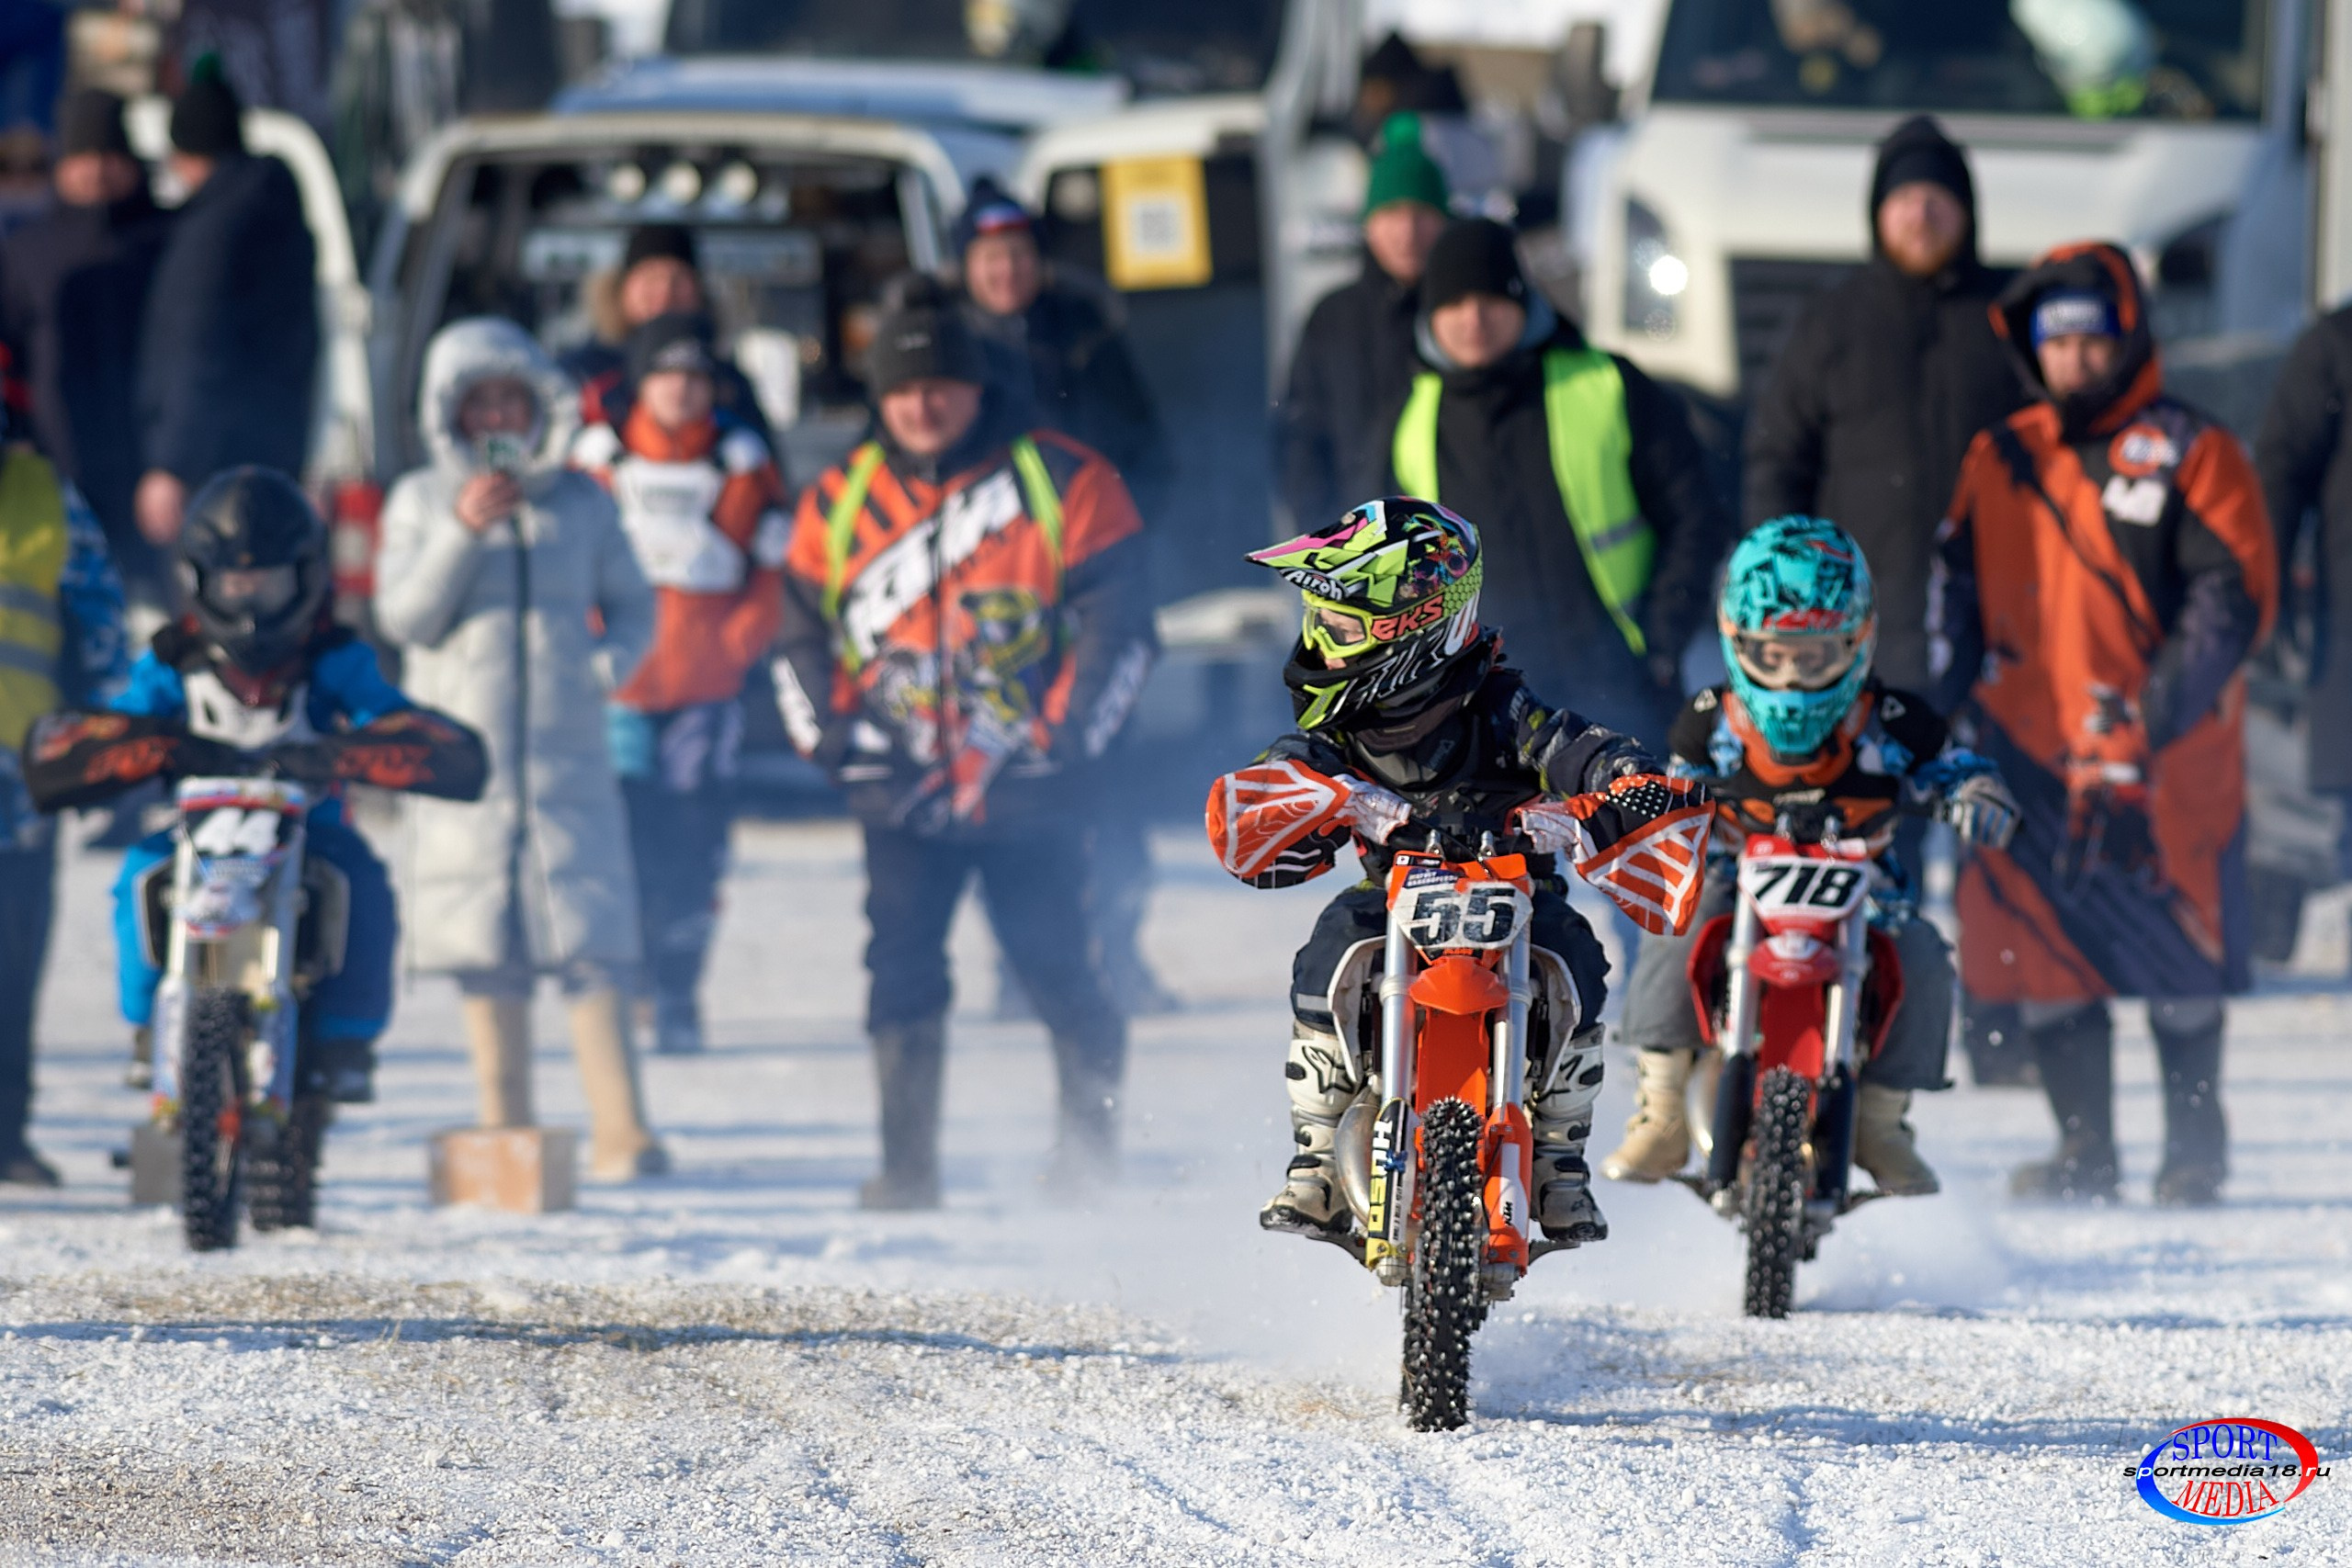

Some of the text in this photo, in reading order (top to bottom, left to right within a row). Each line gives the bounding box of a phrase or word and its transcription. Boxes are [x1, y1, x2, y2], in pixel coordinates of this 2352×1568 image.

[1285, 570, 1342, 602] Airoh
[1755, 864, 1861, 907] 718
[1410, 887, 1516, 946] 55
